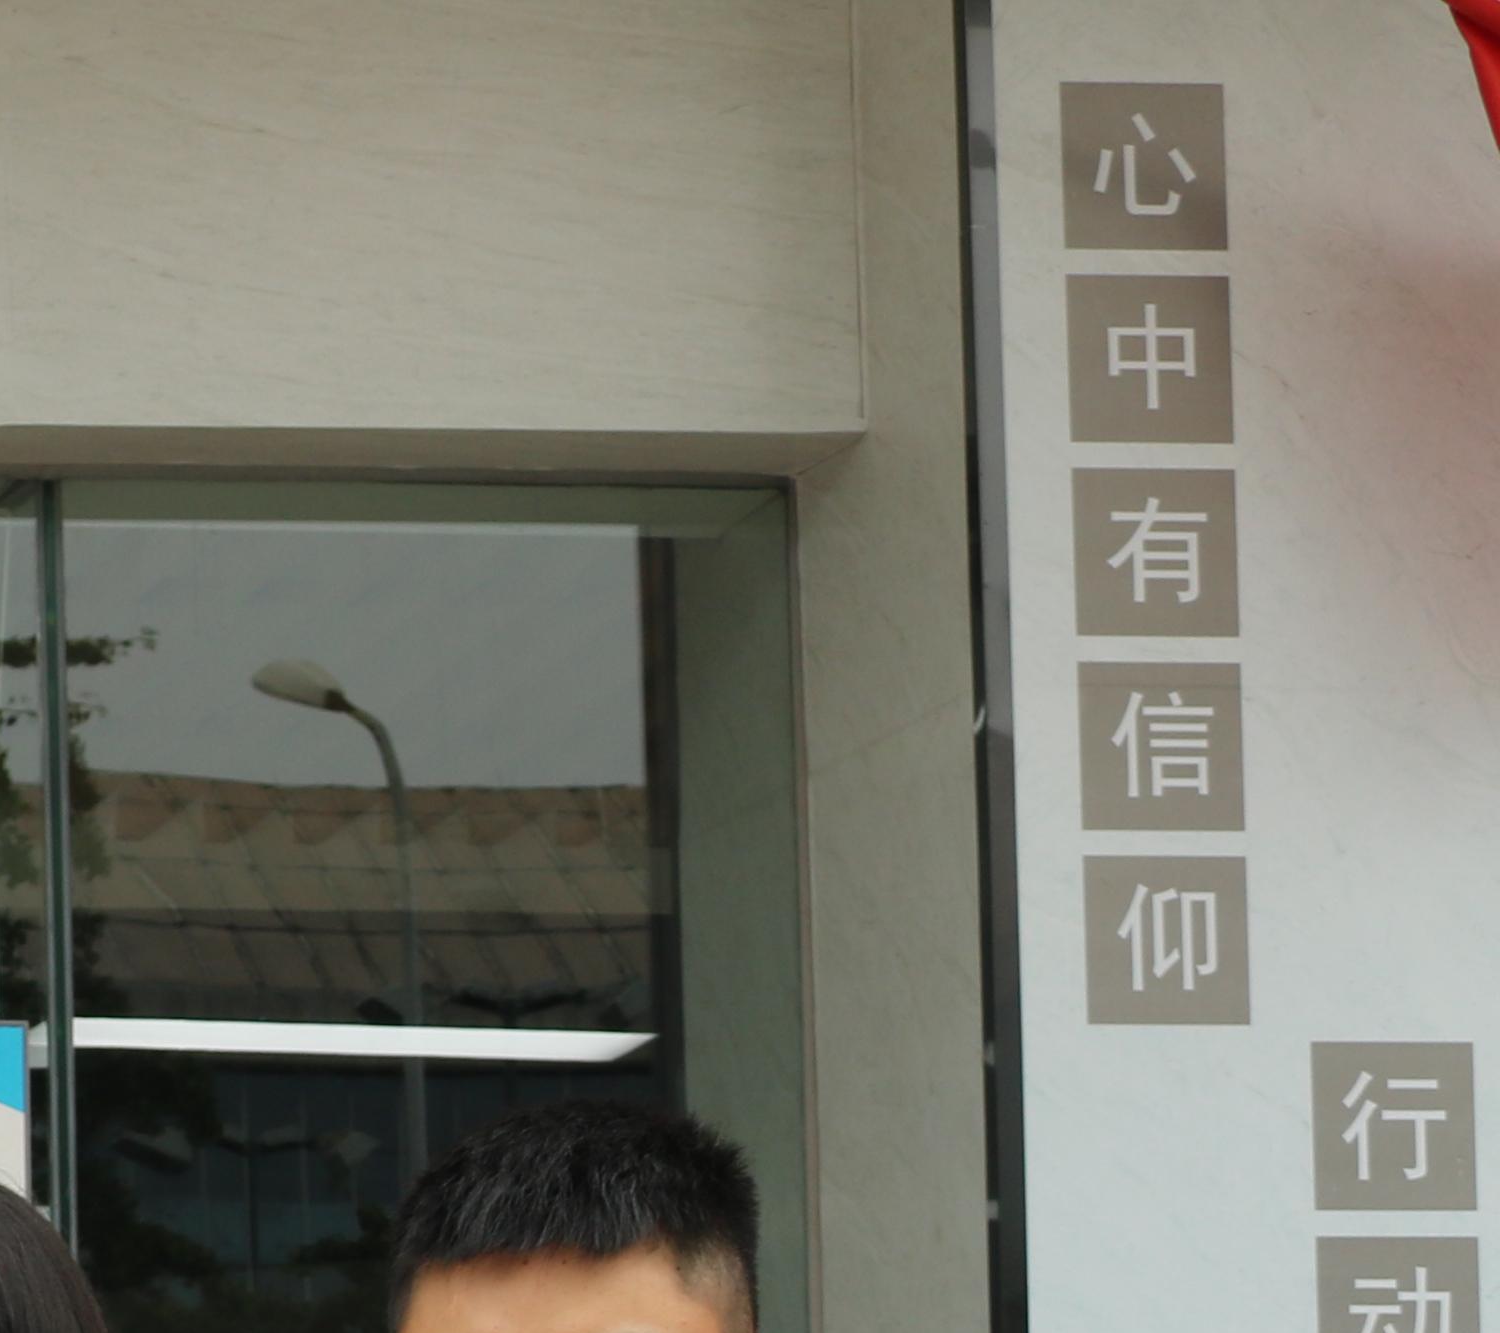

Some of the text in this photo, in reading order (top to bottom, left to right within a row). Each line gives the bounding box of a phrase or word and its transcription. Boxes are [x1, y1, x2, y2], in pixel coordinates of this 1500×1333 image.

[1093, 112, 1219, 992] 心中有信仰
